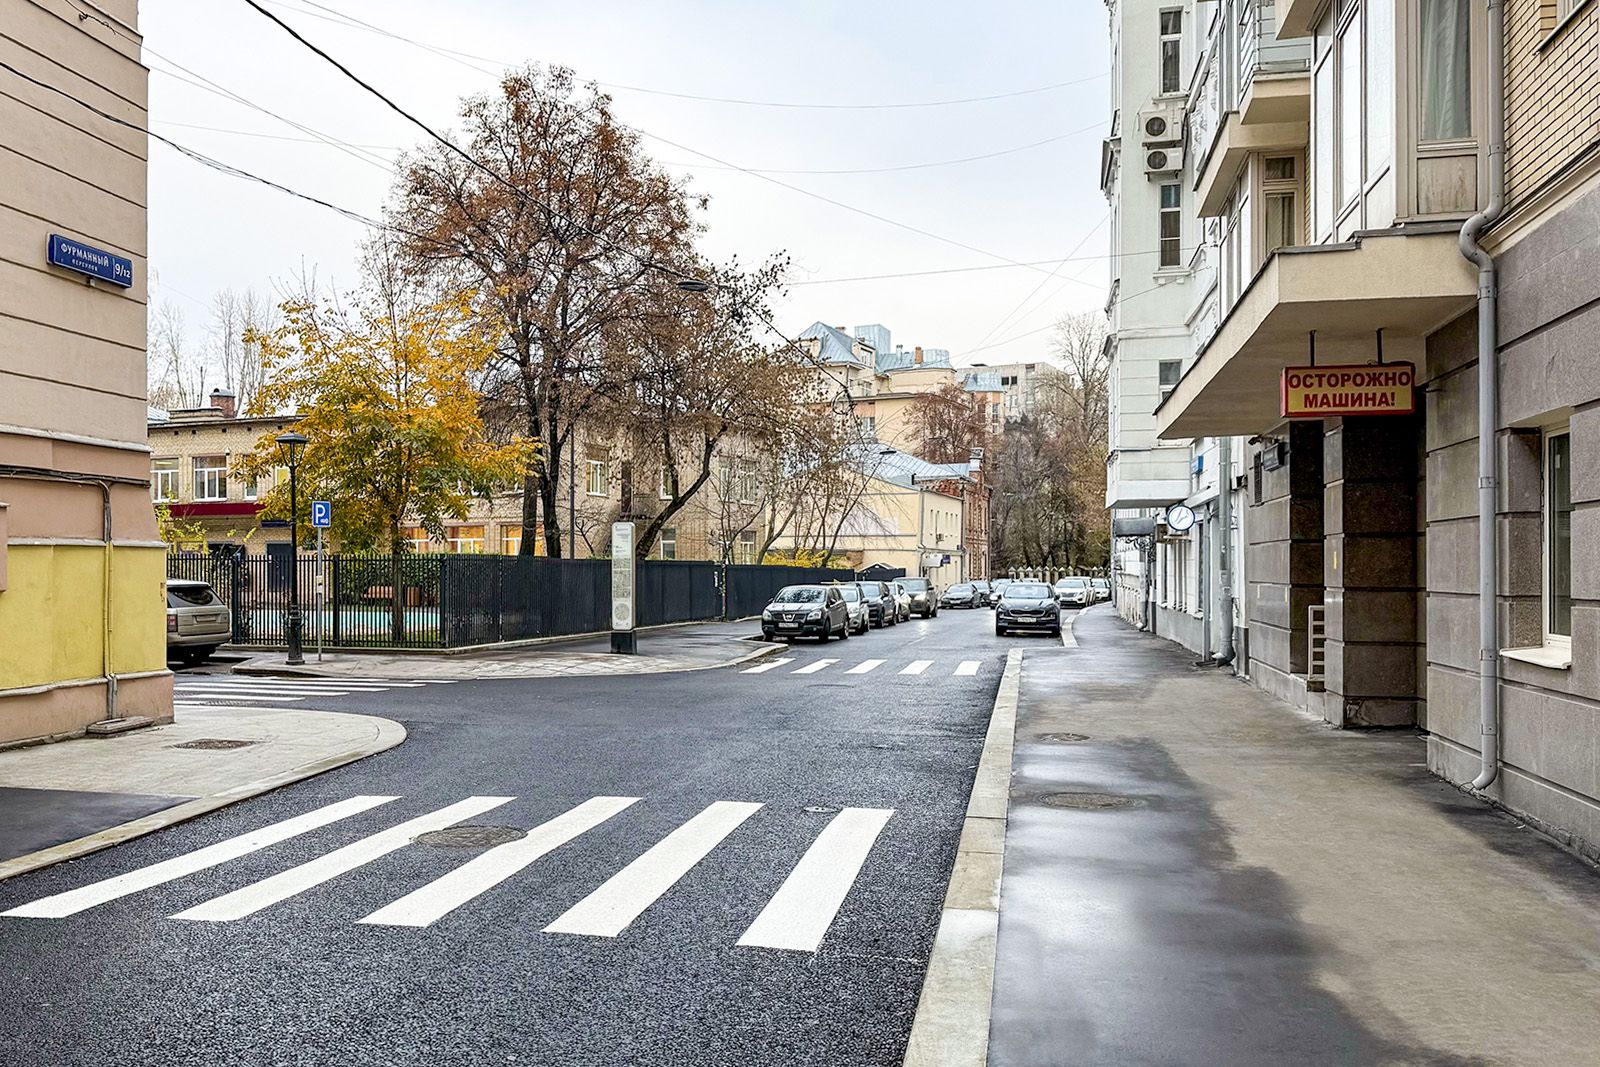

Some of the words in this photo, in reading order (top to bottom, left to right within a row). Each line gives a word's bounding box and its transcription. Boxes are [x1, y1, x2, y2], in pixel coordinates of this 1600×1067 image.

[60, 243, 109, 267] ФУРМАННЫЙ
[115, 263, 131, 278] 9/12
[1288, 371, 1411, 389] ОСТОРОЖНО
[1303, 392, 1395, 408] МАШИНА!
